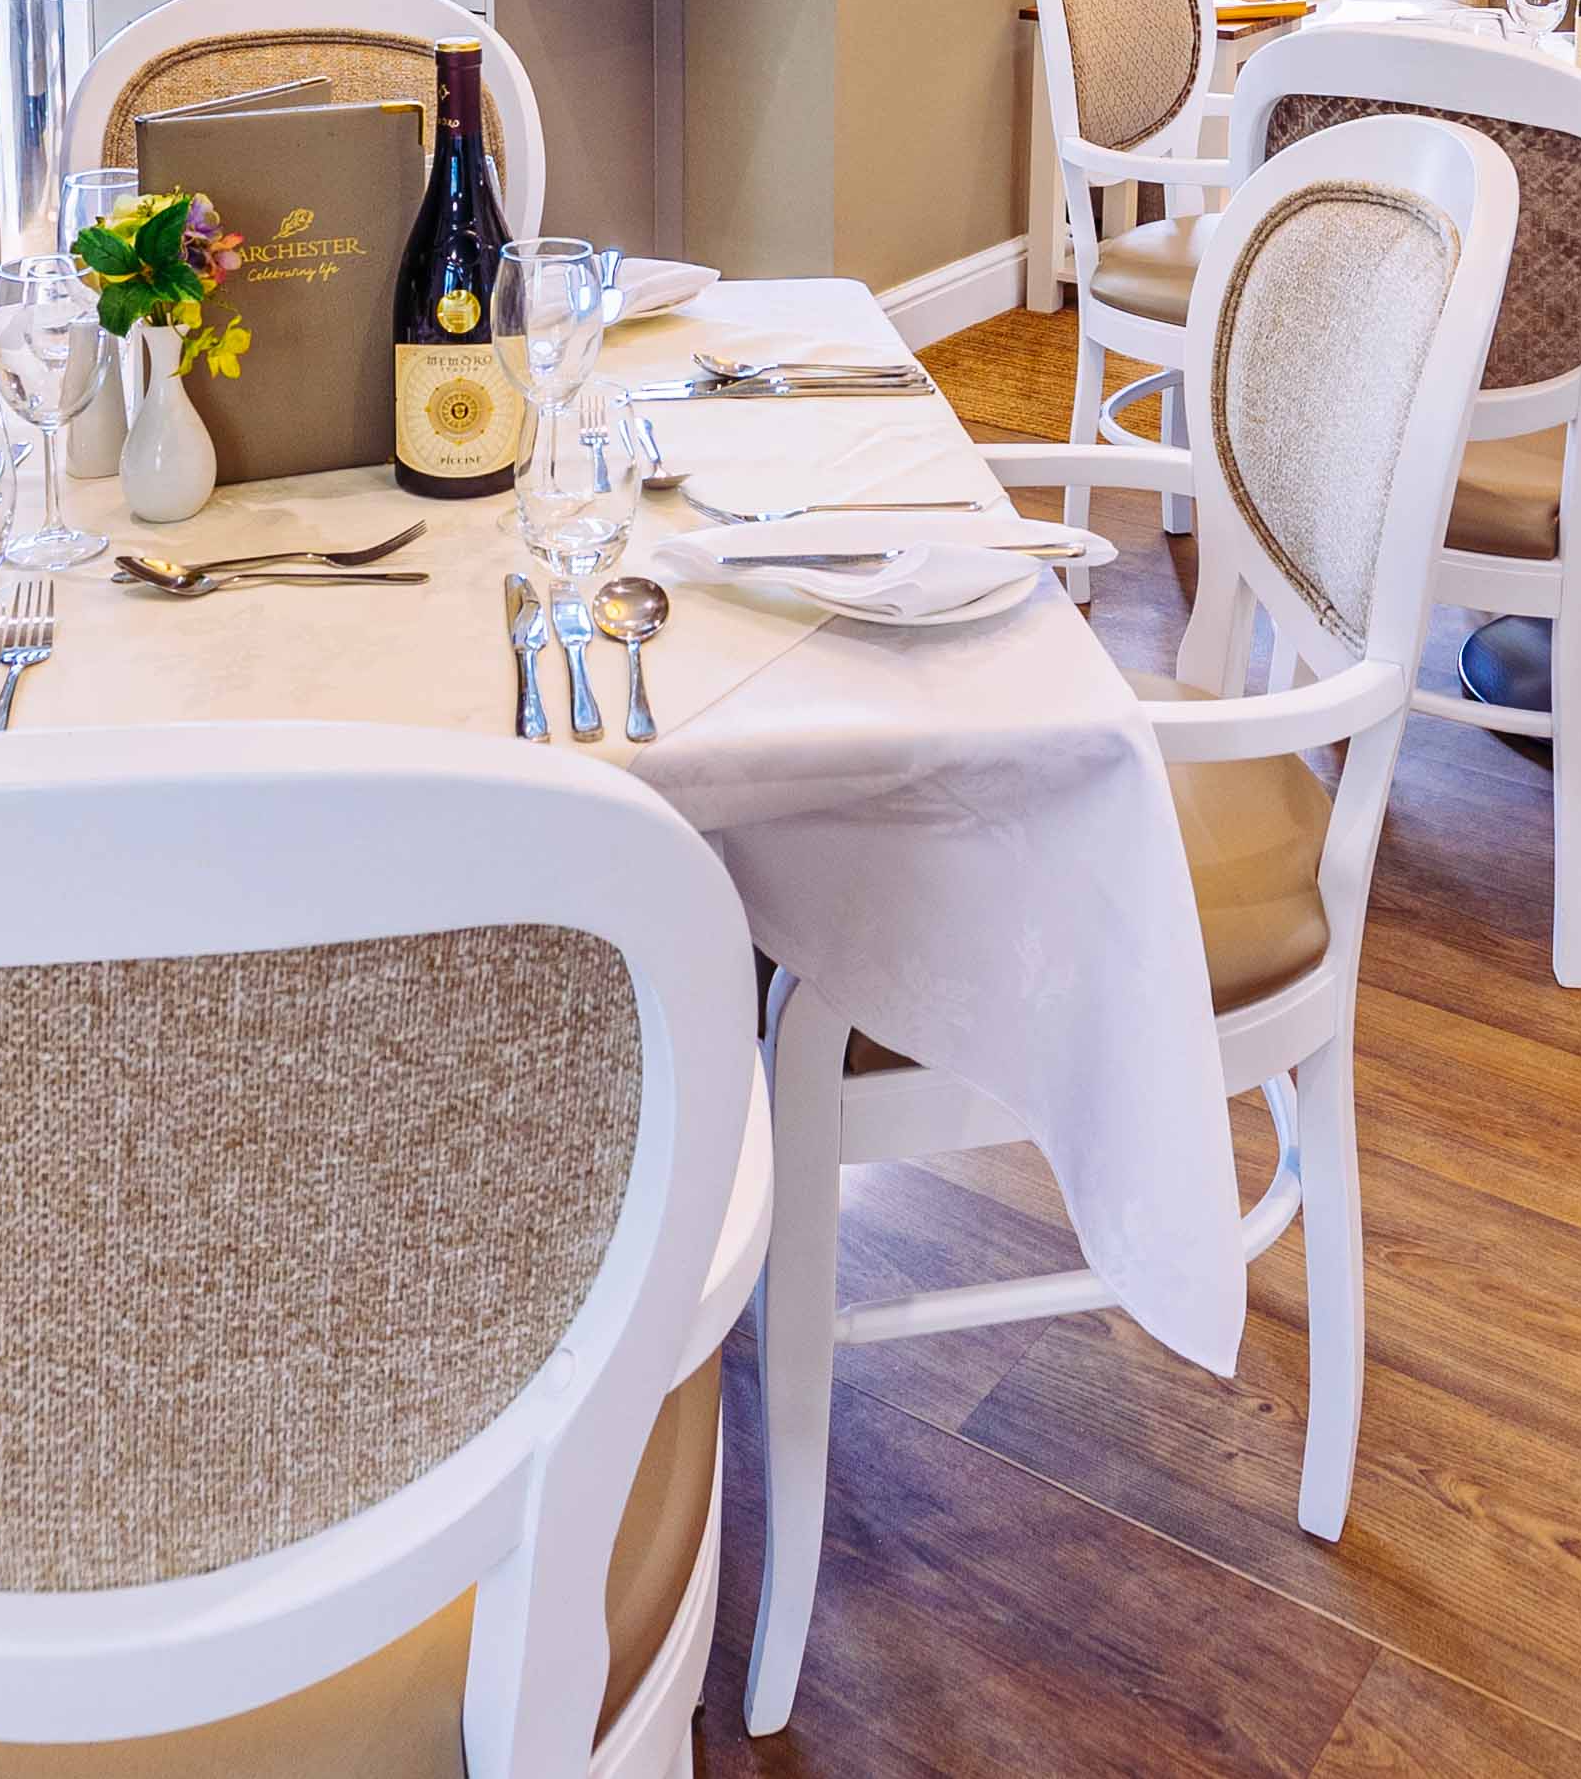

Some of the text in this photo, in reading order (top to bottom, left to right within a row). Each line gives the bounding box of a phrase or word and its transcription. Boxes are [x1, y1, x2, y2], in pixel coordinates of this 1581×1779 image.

[237, 236, 367, 263] ARCHESTER
[247, 261, 340, 283] Celebrating life
